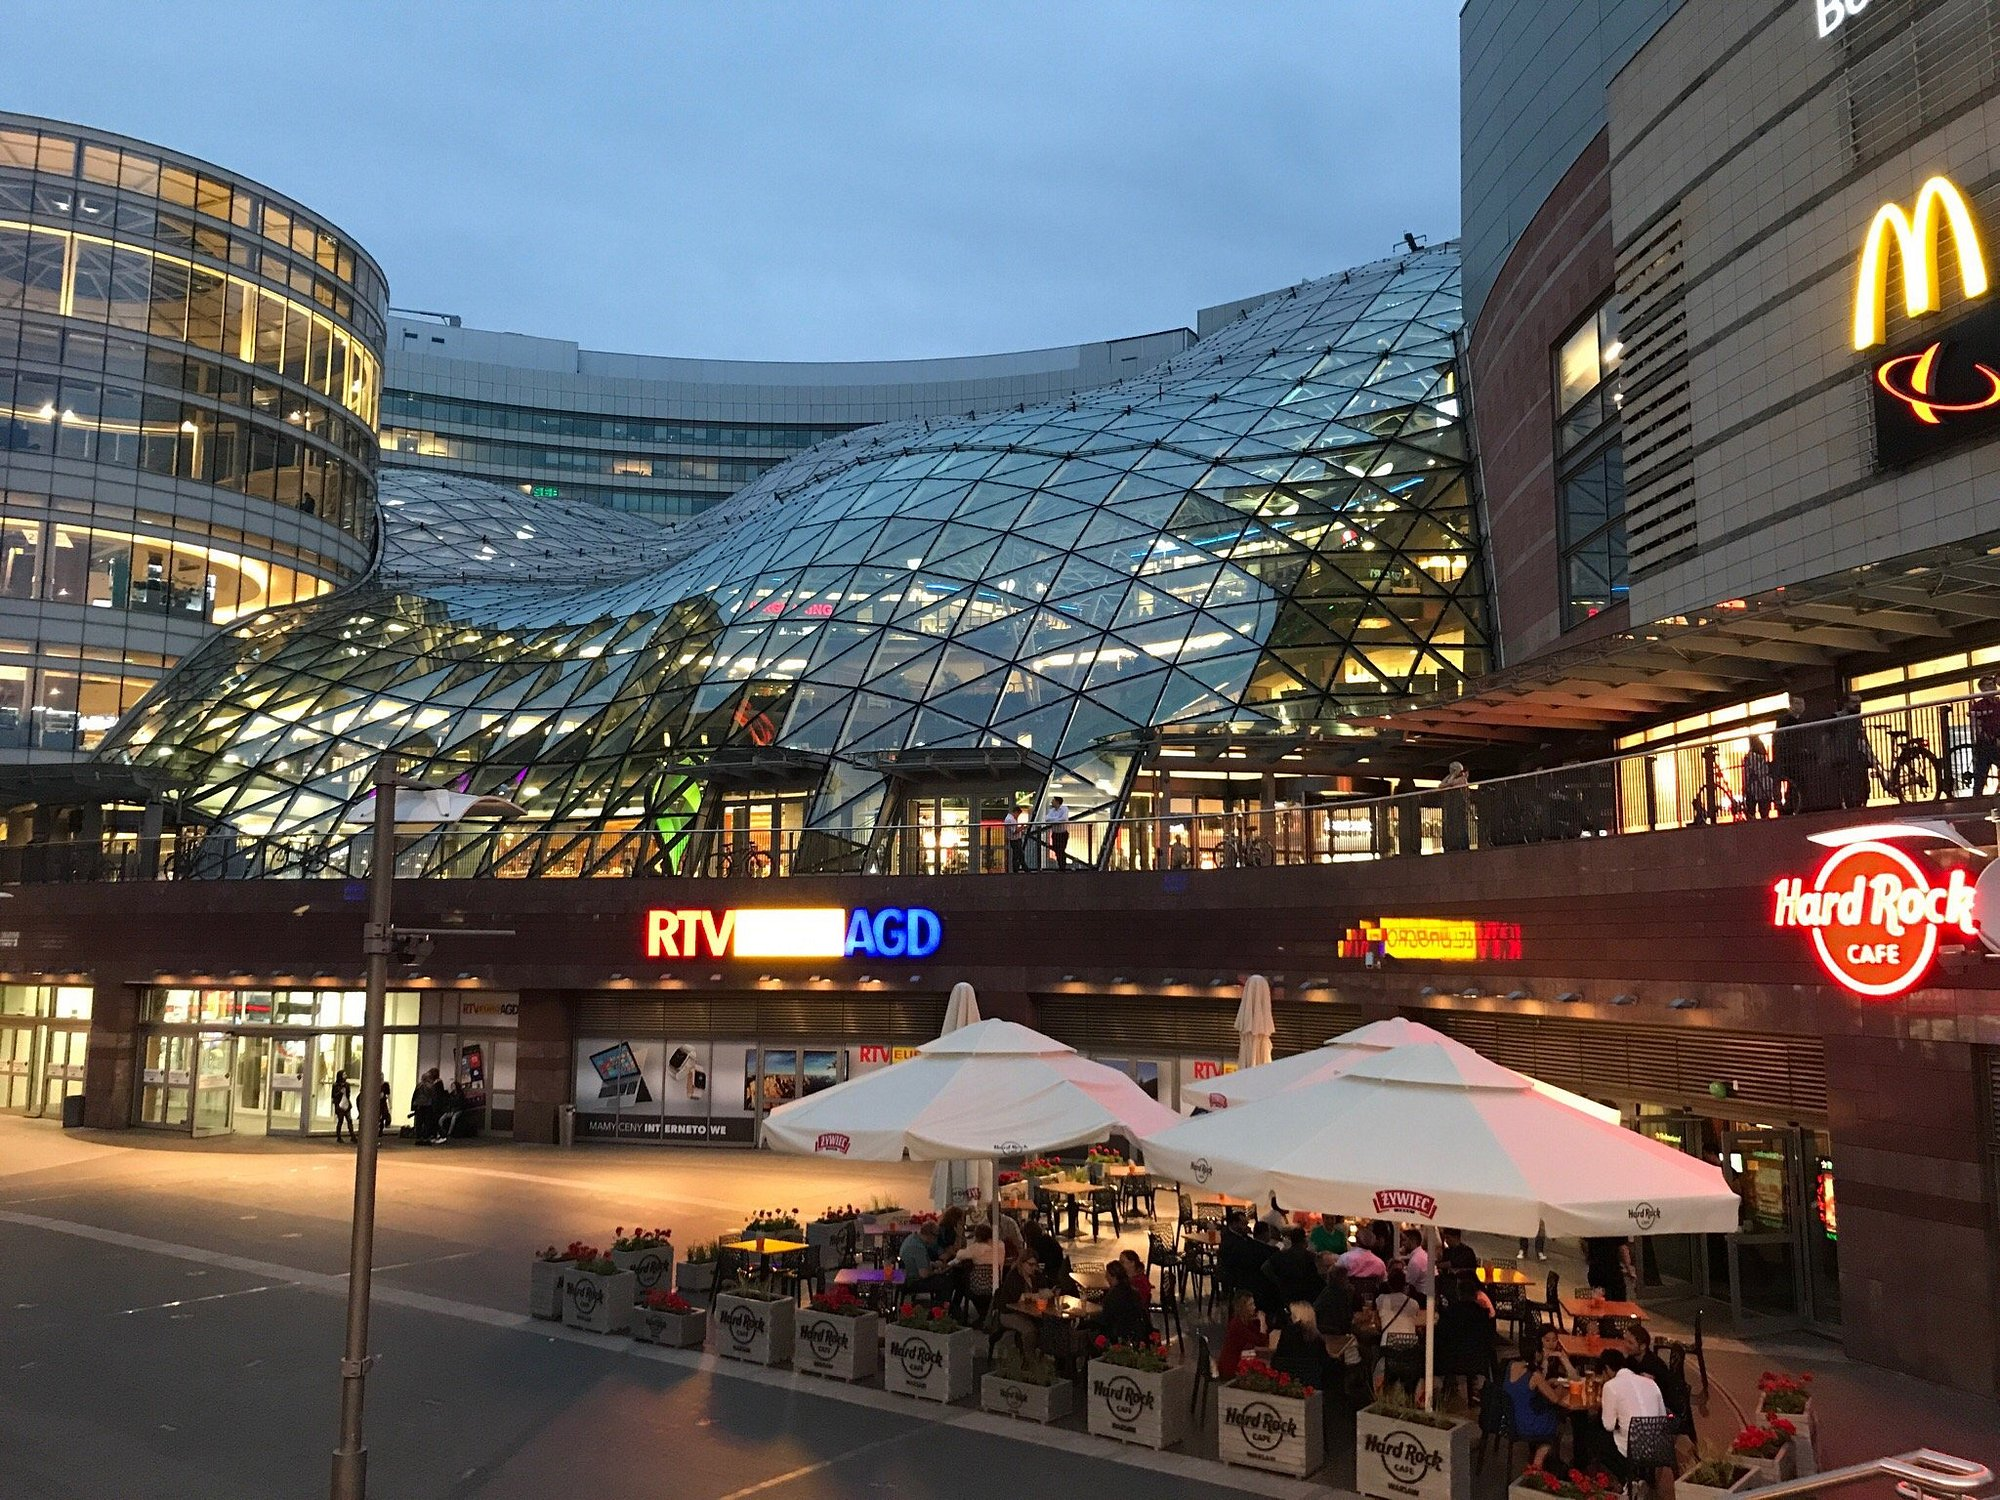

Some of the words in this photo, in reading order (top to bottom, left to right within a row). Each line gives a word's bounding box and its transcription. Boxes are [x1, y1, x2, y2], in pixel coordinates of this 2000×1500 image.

[1774, 874, 1866, 927] Hard
[1869, 869, 1978, 936] Rock
[648, 909, 736, 957] RTV
[844, 908, 942, 957] AGD
[1846, 943, 1901, 965] CAFE
[860, 1045, 890, 1063] RTV
[589, 1121, 617, 1132] MAMY
[618, 1122, 643, 1133] CENY
[890, 1341, 917, 1360] Hard
[917, 1346, 943, 1368] Rock
[1093, 1380, 1125, 1401] Hard
[1125, 1387, 1155, 1410] Rock
[1225, 1407, 1262, 1429] Hard
[1262, 1412, 1297, 1438] Rock
[1365, 1433, 1404, 1459] Hard
[1404, 1443, 1443, 1473] Rock
[1394, 1463, 1416, 1476] CAFE
